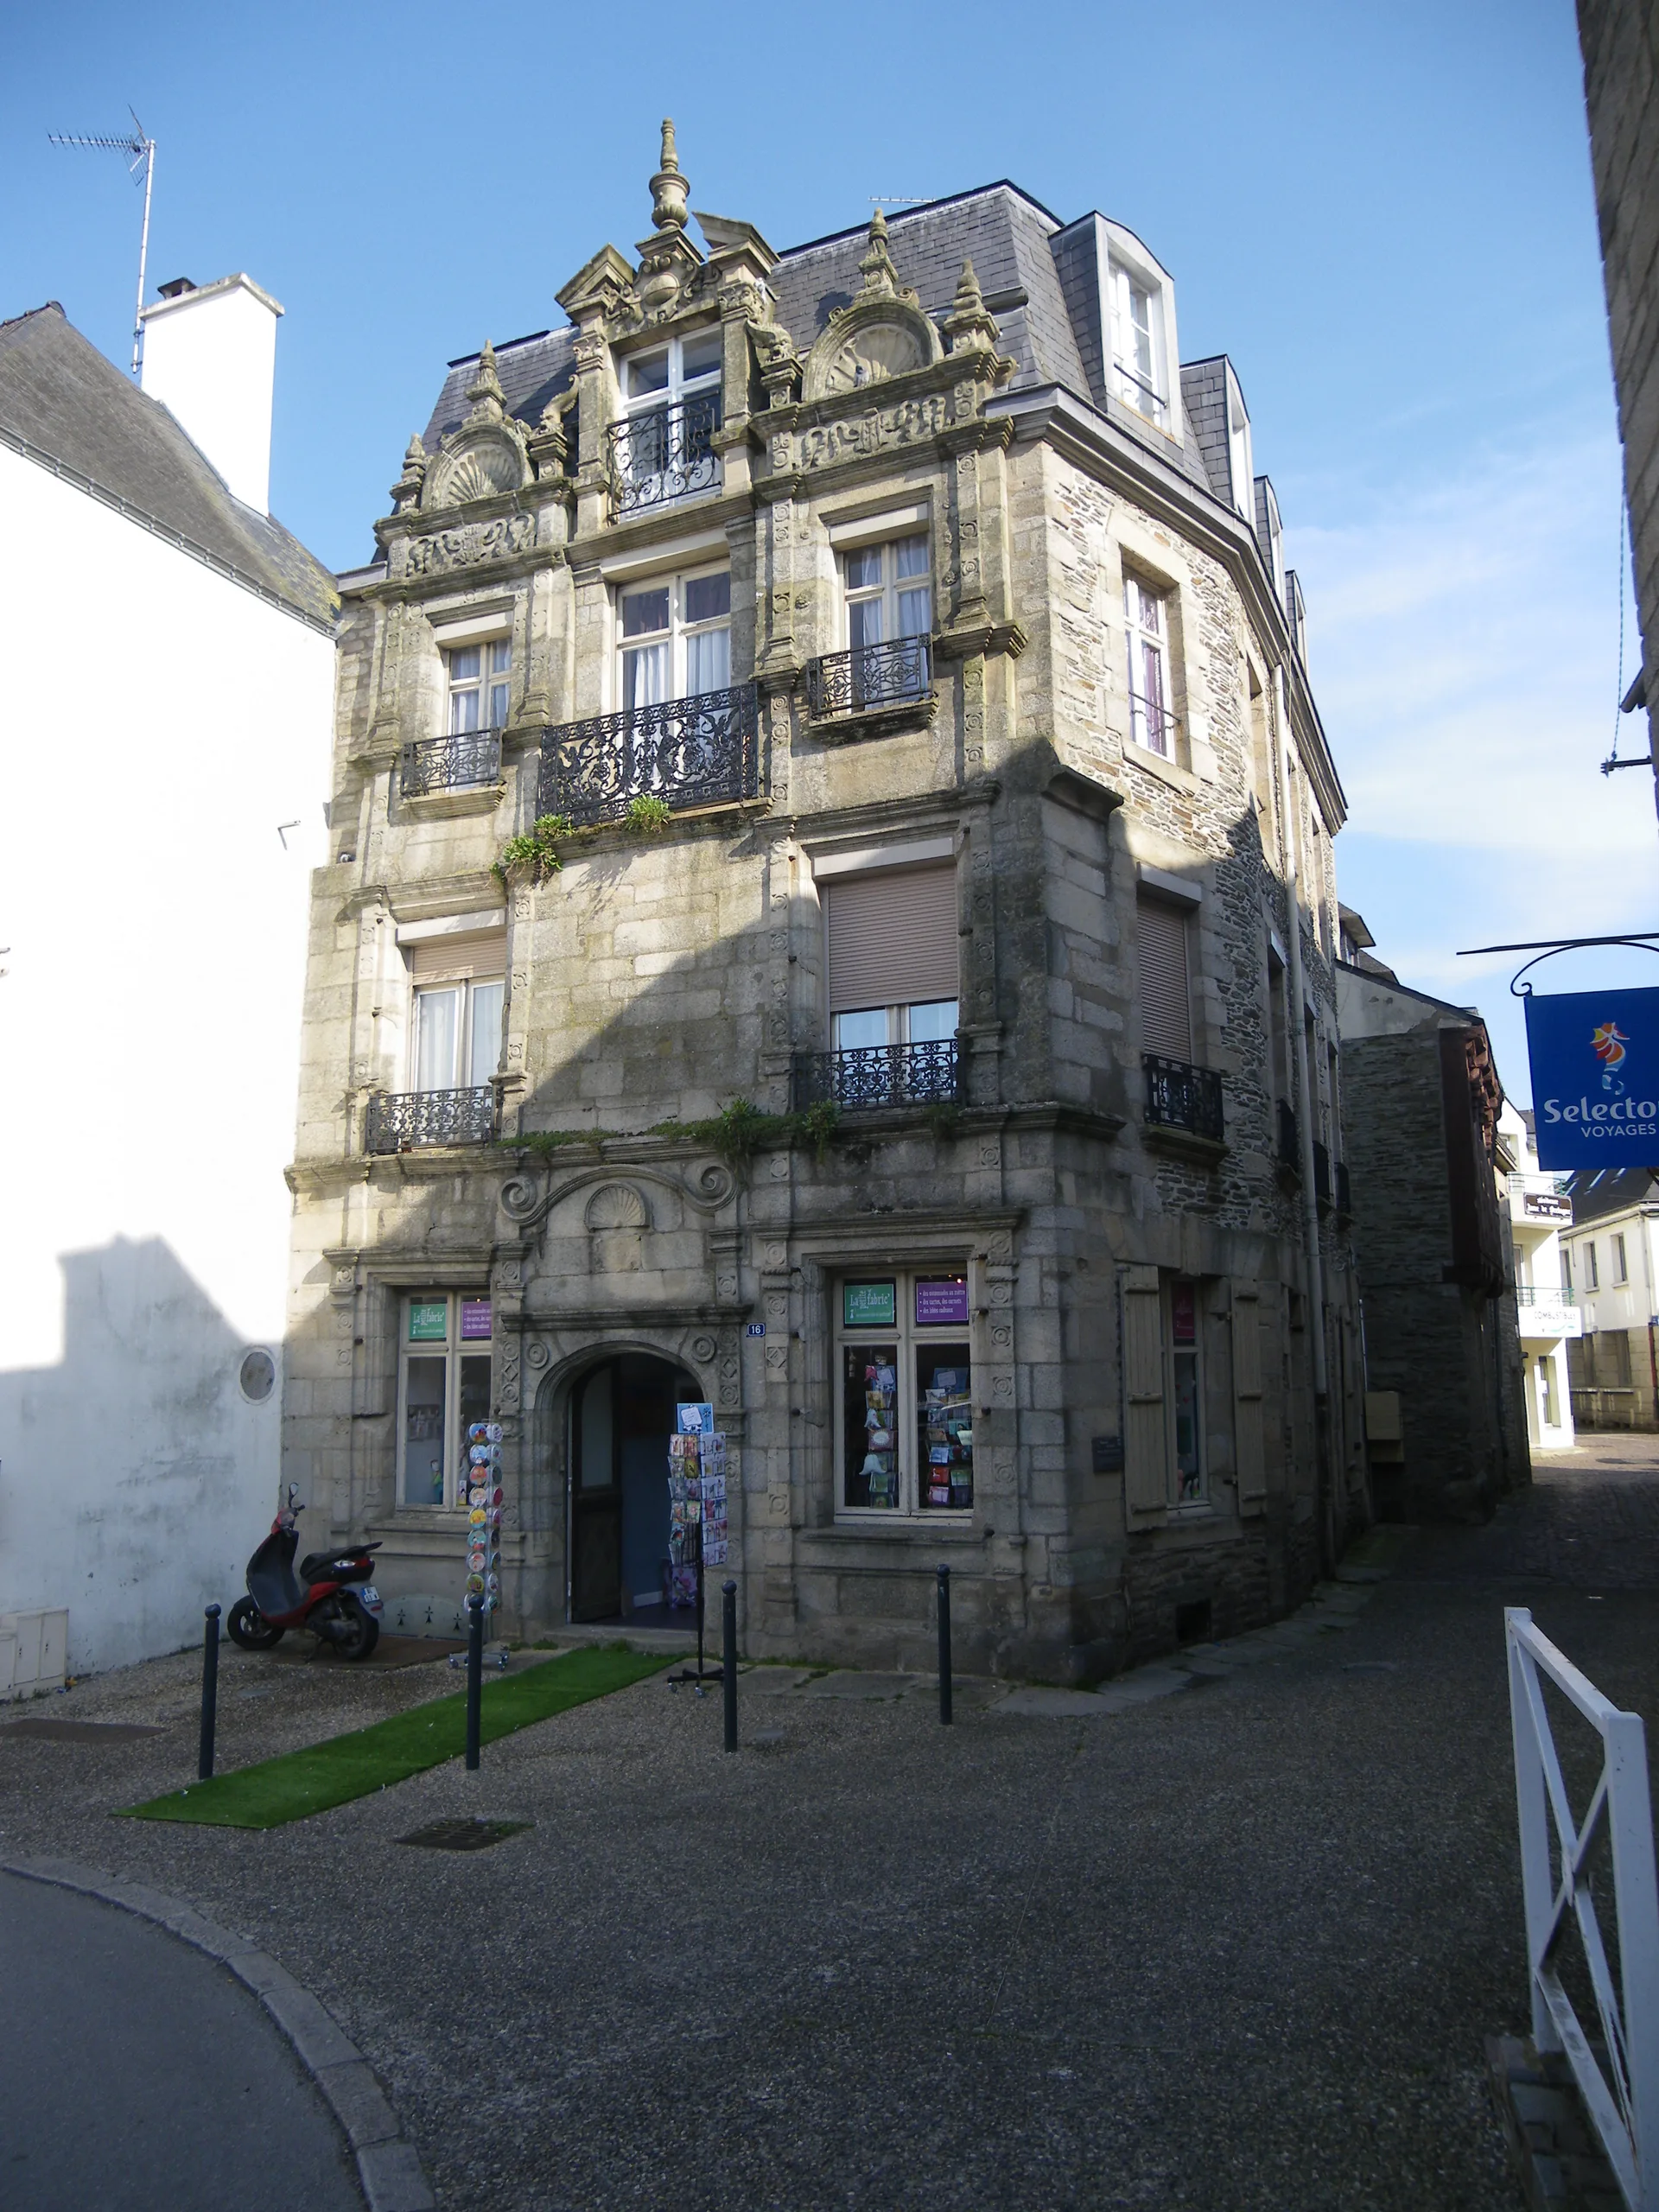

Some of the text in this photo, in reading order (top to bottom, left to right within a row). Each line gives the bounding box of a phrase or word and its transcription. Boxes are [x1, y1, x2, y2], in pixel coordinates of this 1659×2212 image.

[1544, 1096, 1659, 1123] Selecto
[1581, 1123, 1656, 1138] VOYAGES
[752, 1325, 760, 1334] 16
